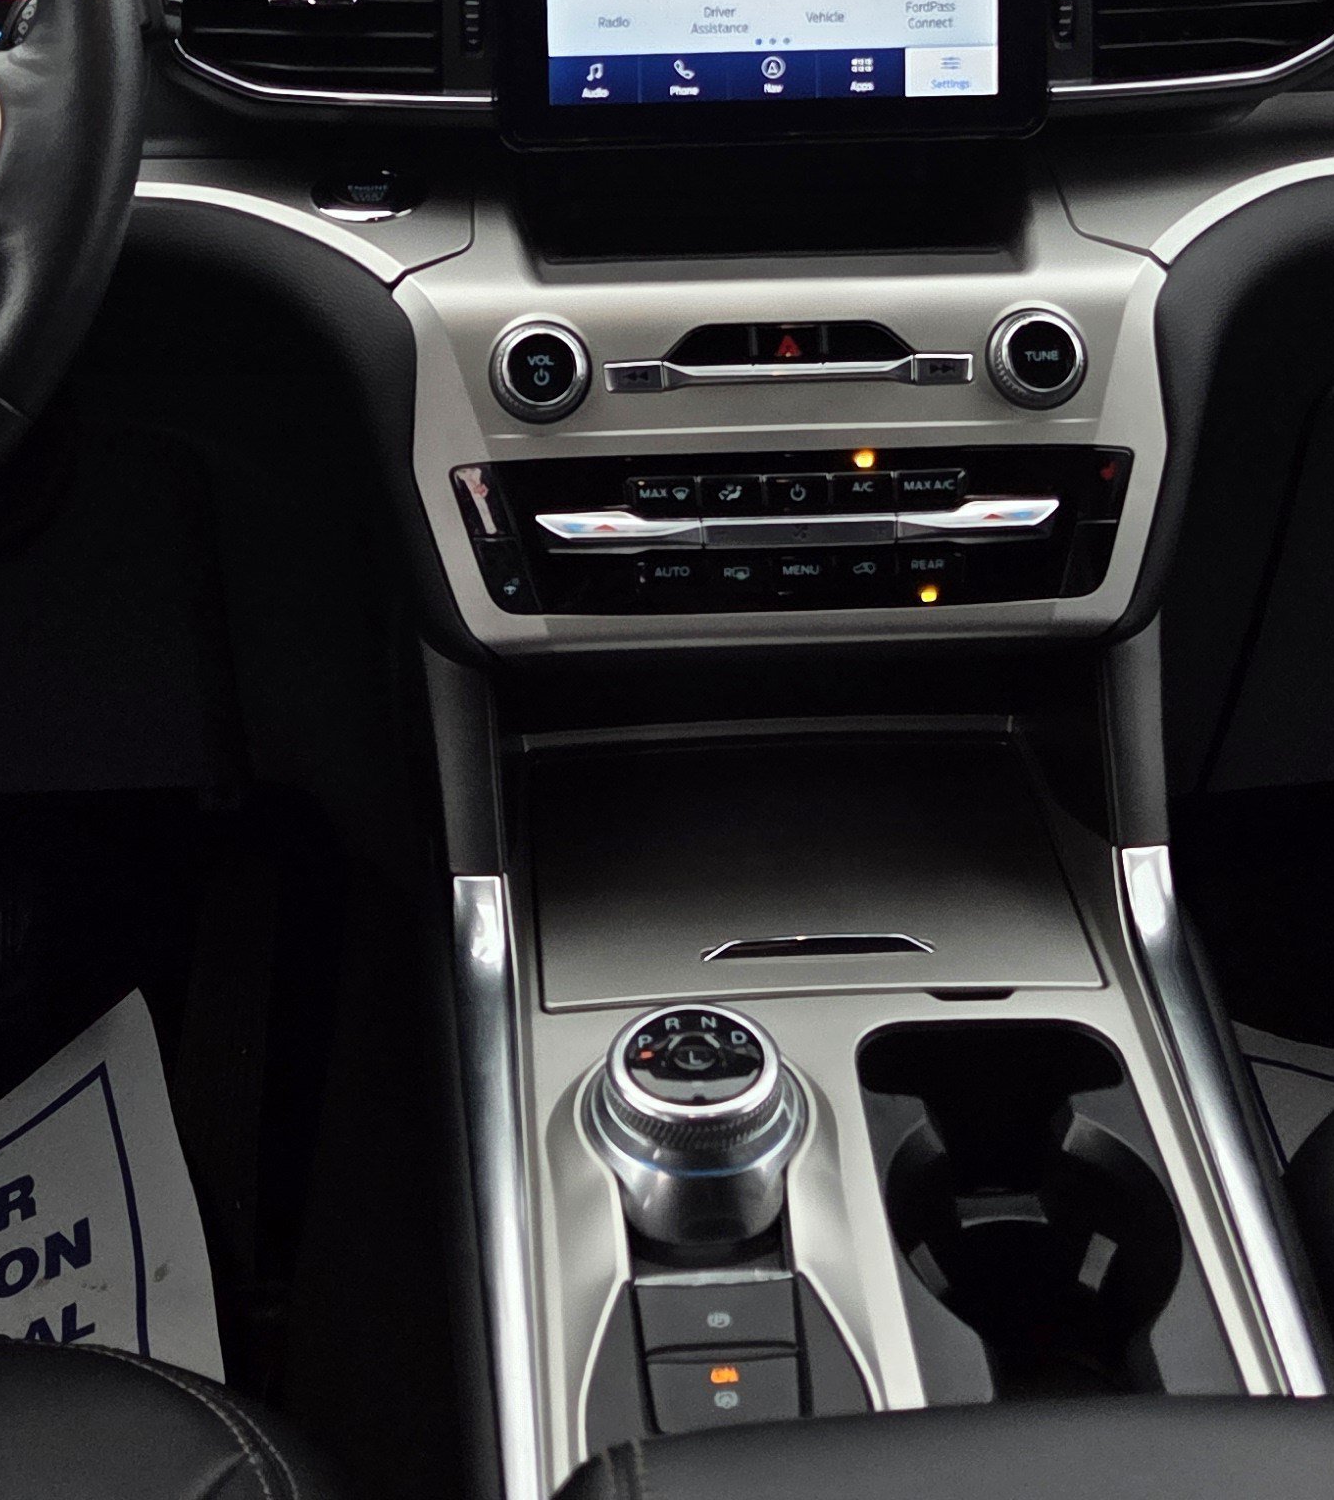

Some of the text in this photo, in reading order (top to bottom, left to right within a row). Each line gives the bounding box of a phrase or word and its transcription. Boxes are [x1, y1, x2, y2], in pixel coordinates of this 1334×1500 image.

[703, 5, 736, 19] Driver
[905, 1, 956, 14] FordPass
[598, 16, 630, 30] Radio
[805, 10, 845, 24] Vehicle
[908, 16, 953, 30] Connect
[691, 21, 749, 35] Assistance
[669, 85, 700, 97] Phone
[930, 78, 971, 92] Settings
[527, 355, 554, 367] VOL
[1024, 350, 1059, 363] TUNE
[852, 480, 875, 494] A/C
[903, 478, 956, 494] MAX A/C
[639, 487, 668, 501] MAX
[654, 565, 690, 579] AUTO
[782, 563, 819, 577] MENU
[910, 558, 945, 572] REAR
[638, 1015, 749, 1049] P R N D
[688, 1050, 703, 1065] L
